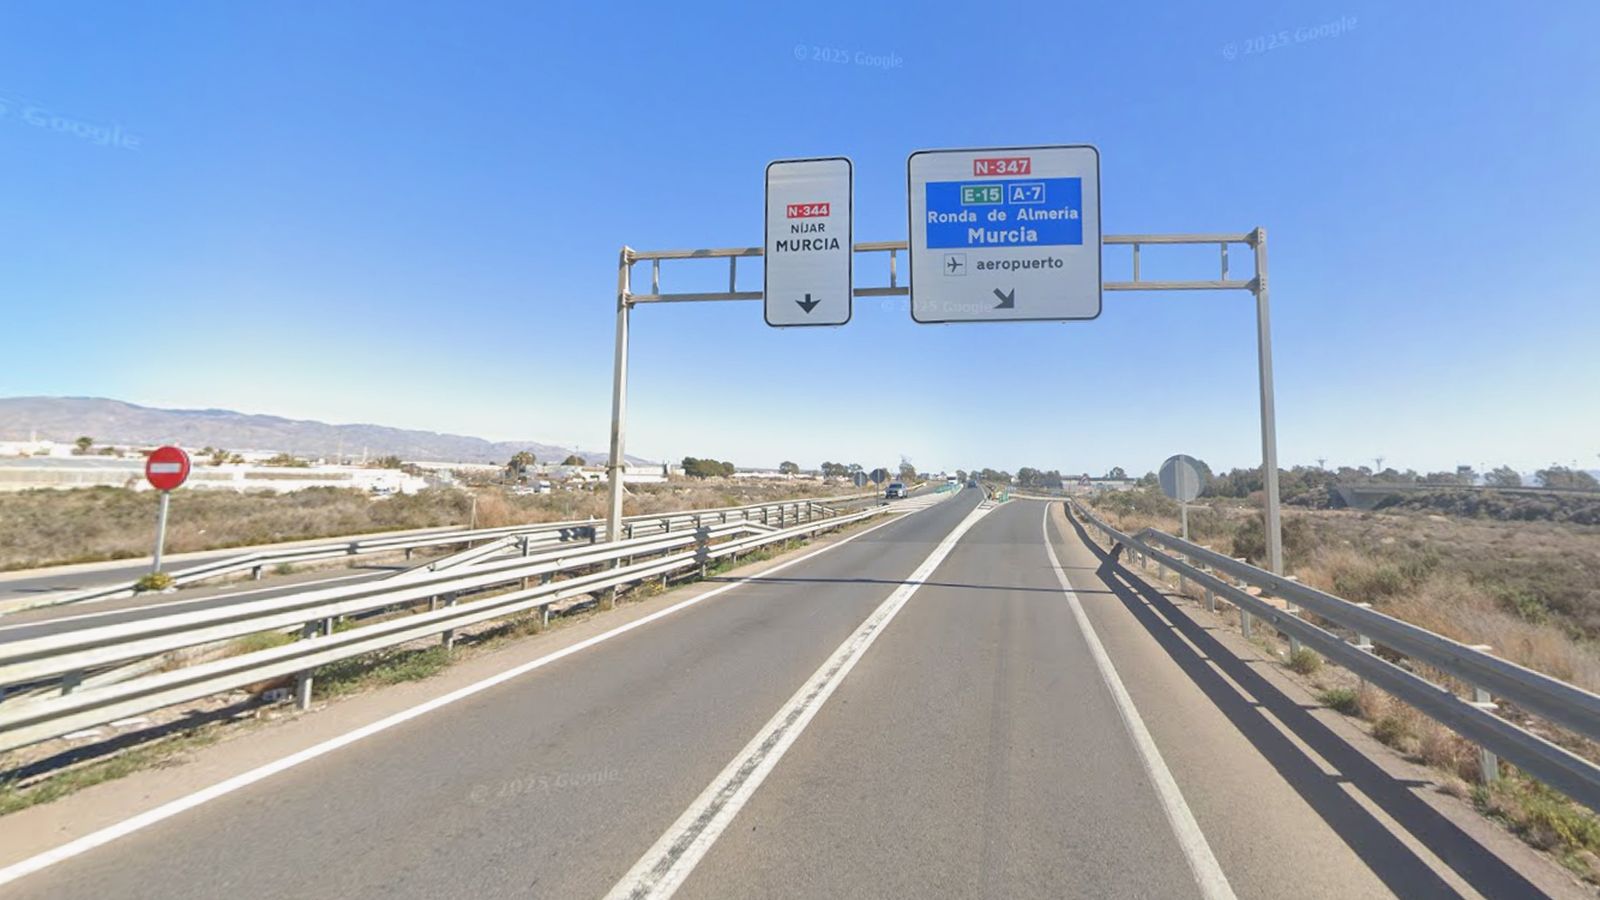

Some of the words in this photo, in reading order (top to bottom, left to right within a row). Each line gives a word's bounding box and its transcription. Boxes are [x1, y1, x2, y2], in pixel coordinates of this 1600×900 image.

[975, 159, 1029, 175] N-347
[964, 187, 1000, 202] E-15
[1012, 186, 1041, 201] A-7
[788, 205, 828, 217] N-344
[927, 209, 977, 224] Ronda
[987, 208, 1007, 222] de
[967, 226, 1038, 244] Murcia
[776, 237, 840, 252] MURCIA
[976, 256, 1064, 272] aeropuerto
